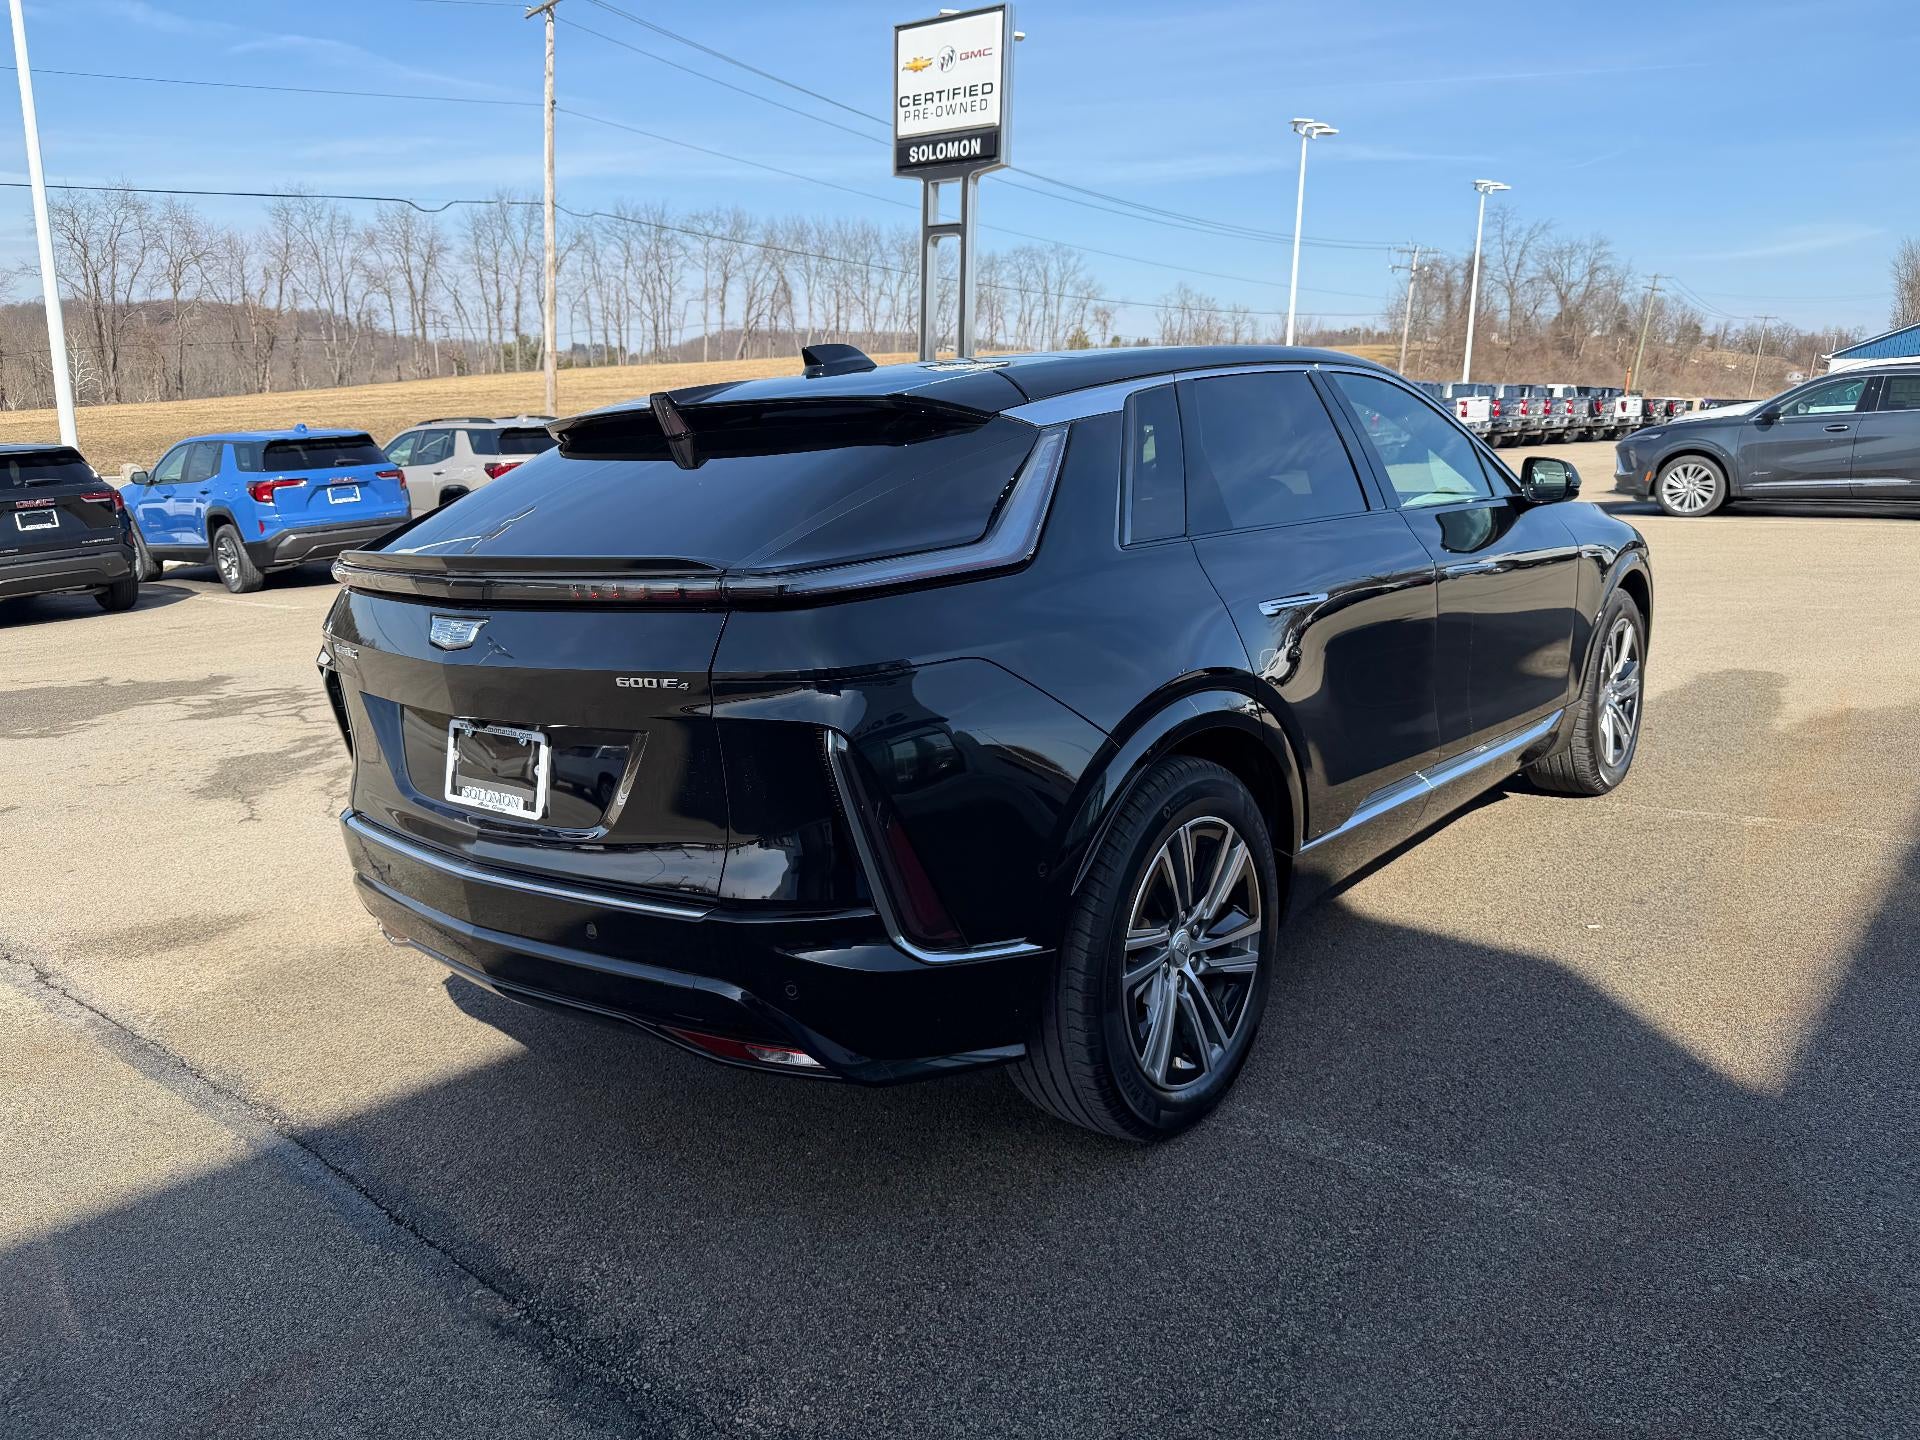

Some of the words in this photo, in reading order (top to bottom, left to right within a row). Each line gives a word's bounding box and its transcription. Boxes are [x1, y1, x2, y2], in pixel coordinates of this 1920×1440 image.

[959, 47, 993, 61] GMC
[899, 82, 994, 109] CERTIFIED
[903, 98, 988, 122] PRE-OWNED
[909, 137, 982, 163] SOLOMON
[462, 785, 521, 809] SOLOMON
